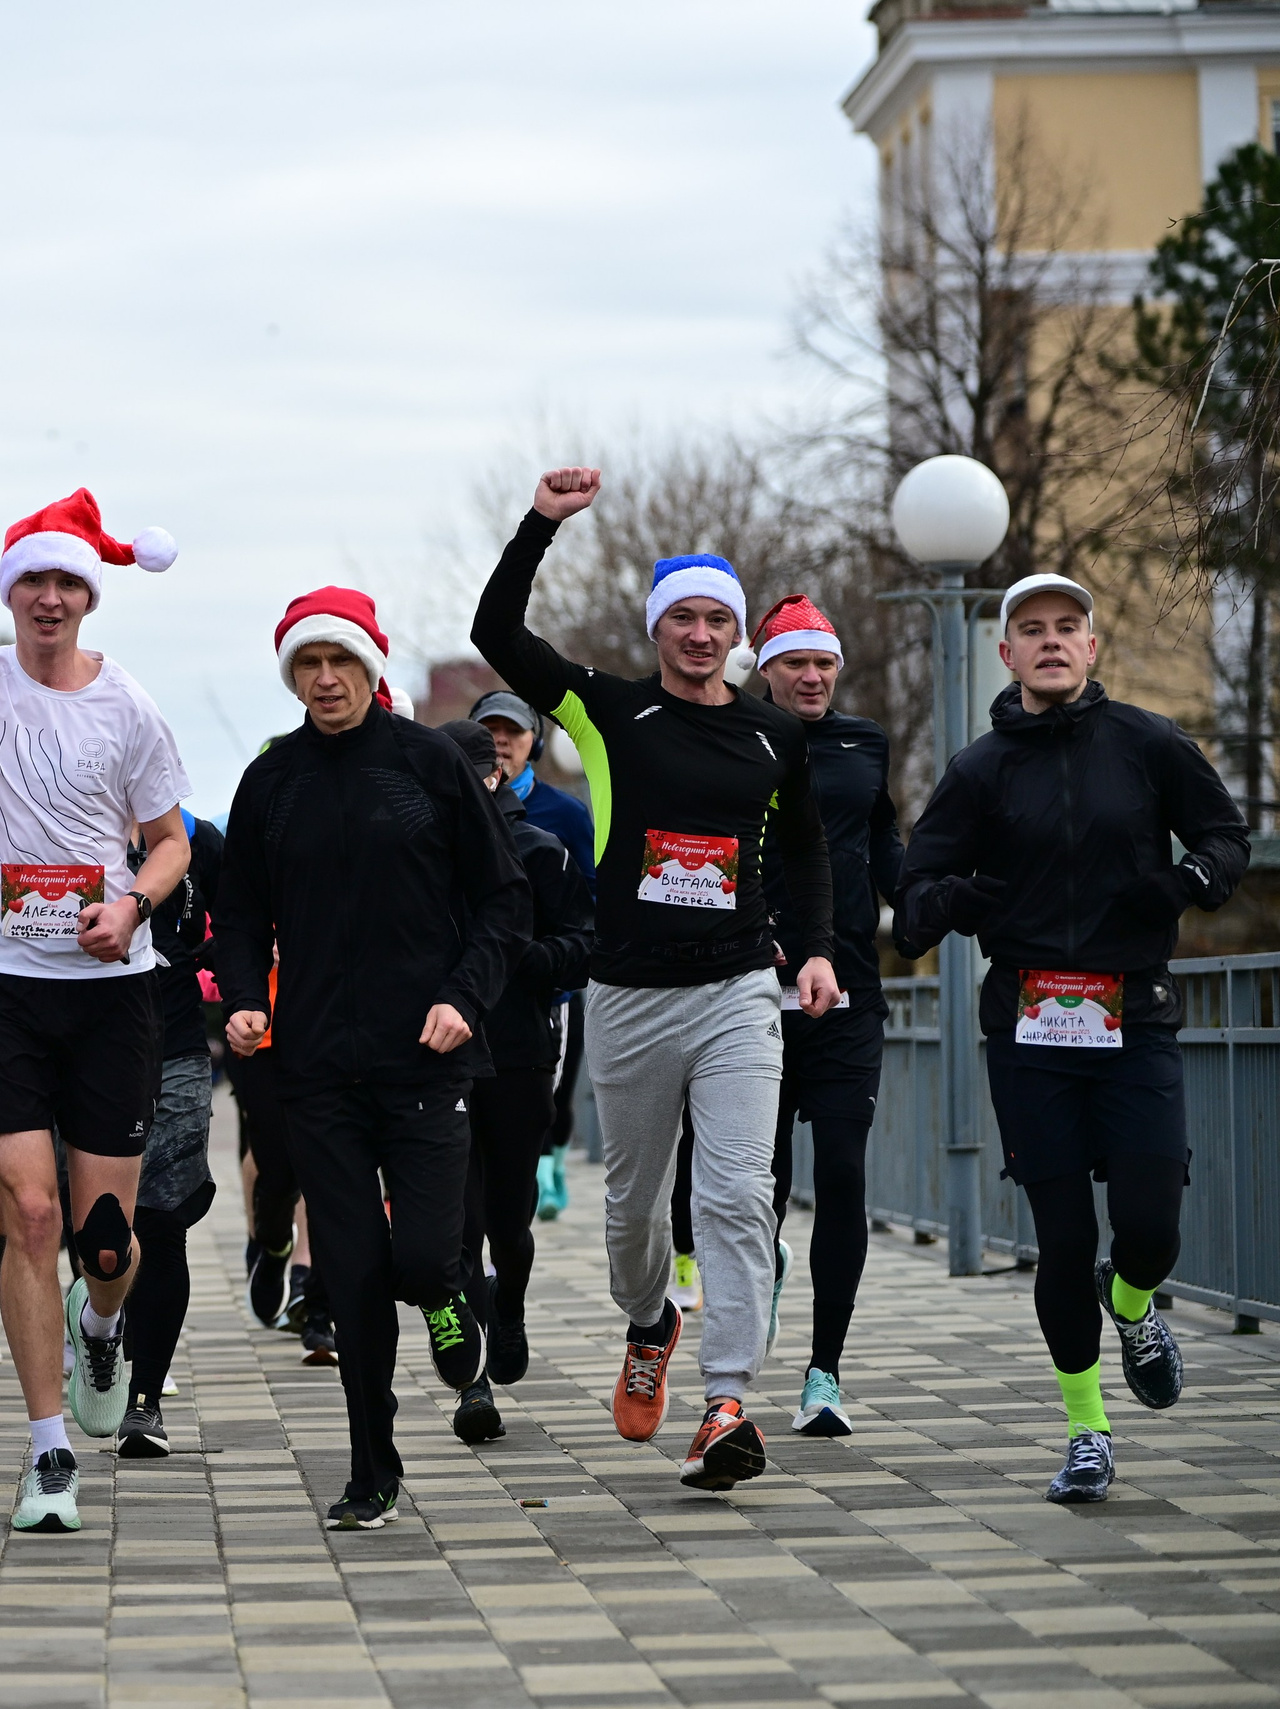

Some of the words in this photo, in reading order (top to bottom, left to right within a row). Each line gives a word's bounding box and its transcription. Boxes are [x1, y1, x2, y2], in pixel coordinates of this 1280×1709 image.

[78, 760, 106, 772] БАЗА
[662, 842, 706, 857] Новогодний
[706, 846, 724, 858] забег
[20, 874, 66, 888] Новогодний
[66, 874, 86, 887] забег
[1036, 980, 1083, 994] Новогодний
[1083, 982, 1105, 994] забег
[1040, 1016, 1086, 1028] НИКИТА
